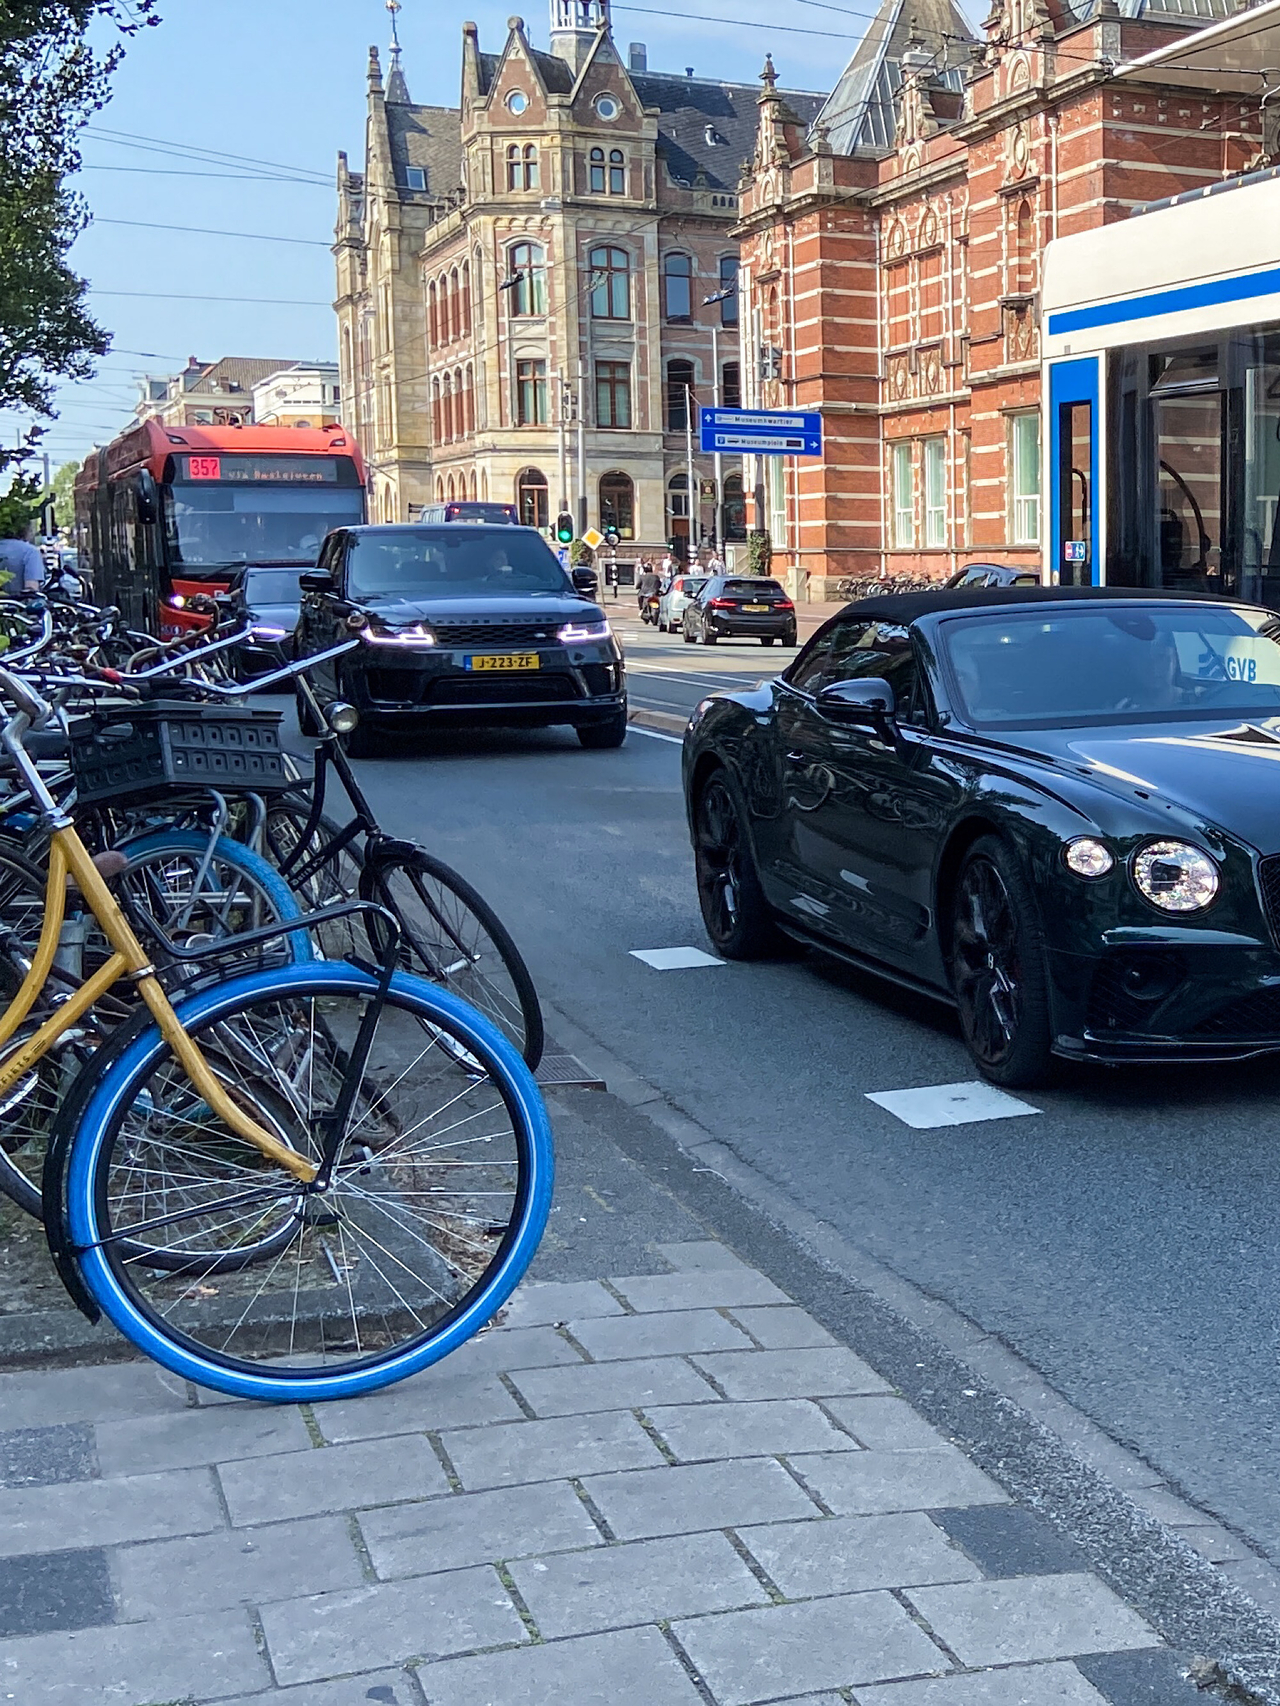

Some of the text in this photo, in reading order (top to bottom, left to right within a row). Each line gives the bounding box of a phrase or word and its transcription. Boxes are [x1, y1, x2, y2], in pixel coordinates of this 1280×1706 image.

[735, 416, 793, 425] Museumkwartier
[191, 459, 218, 476] 357
[479, 657, 533, 668] J-223-ZF
[1227, 656, 1256, 681] GVB
[0, 1055, 30, 1087] FIETS
